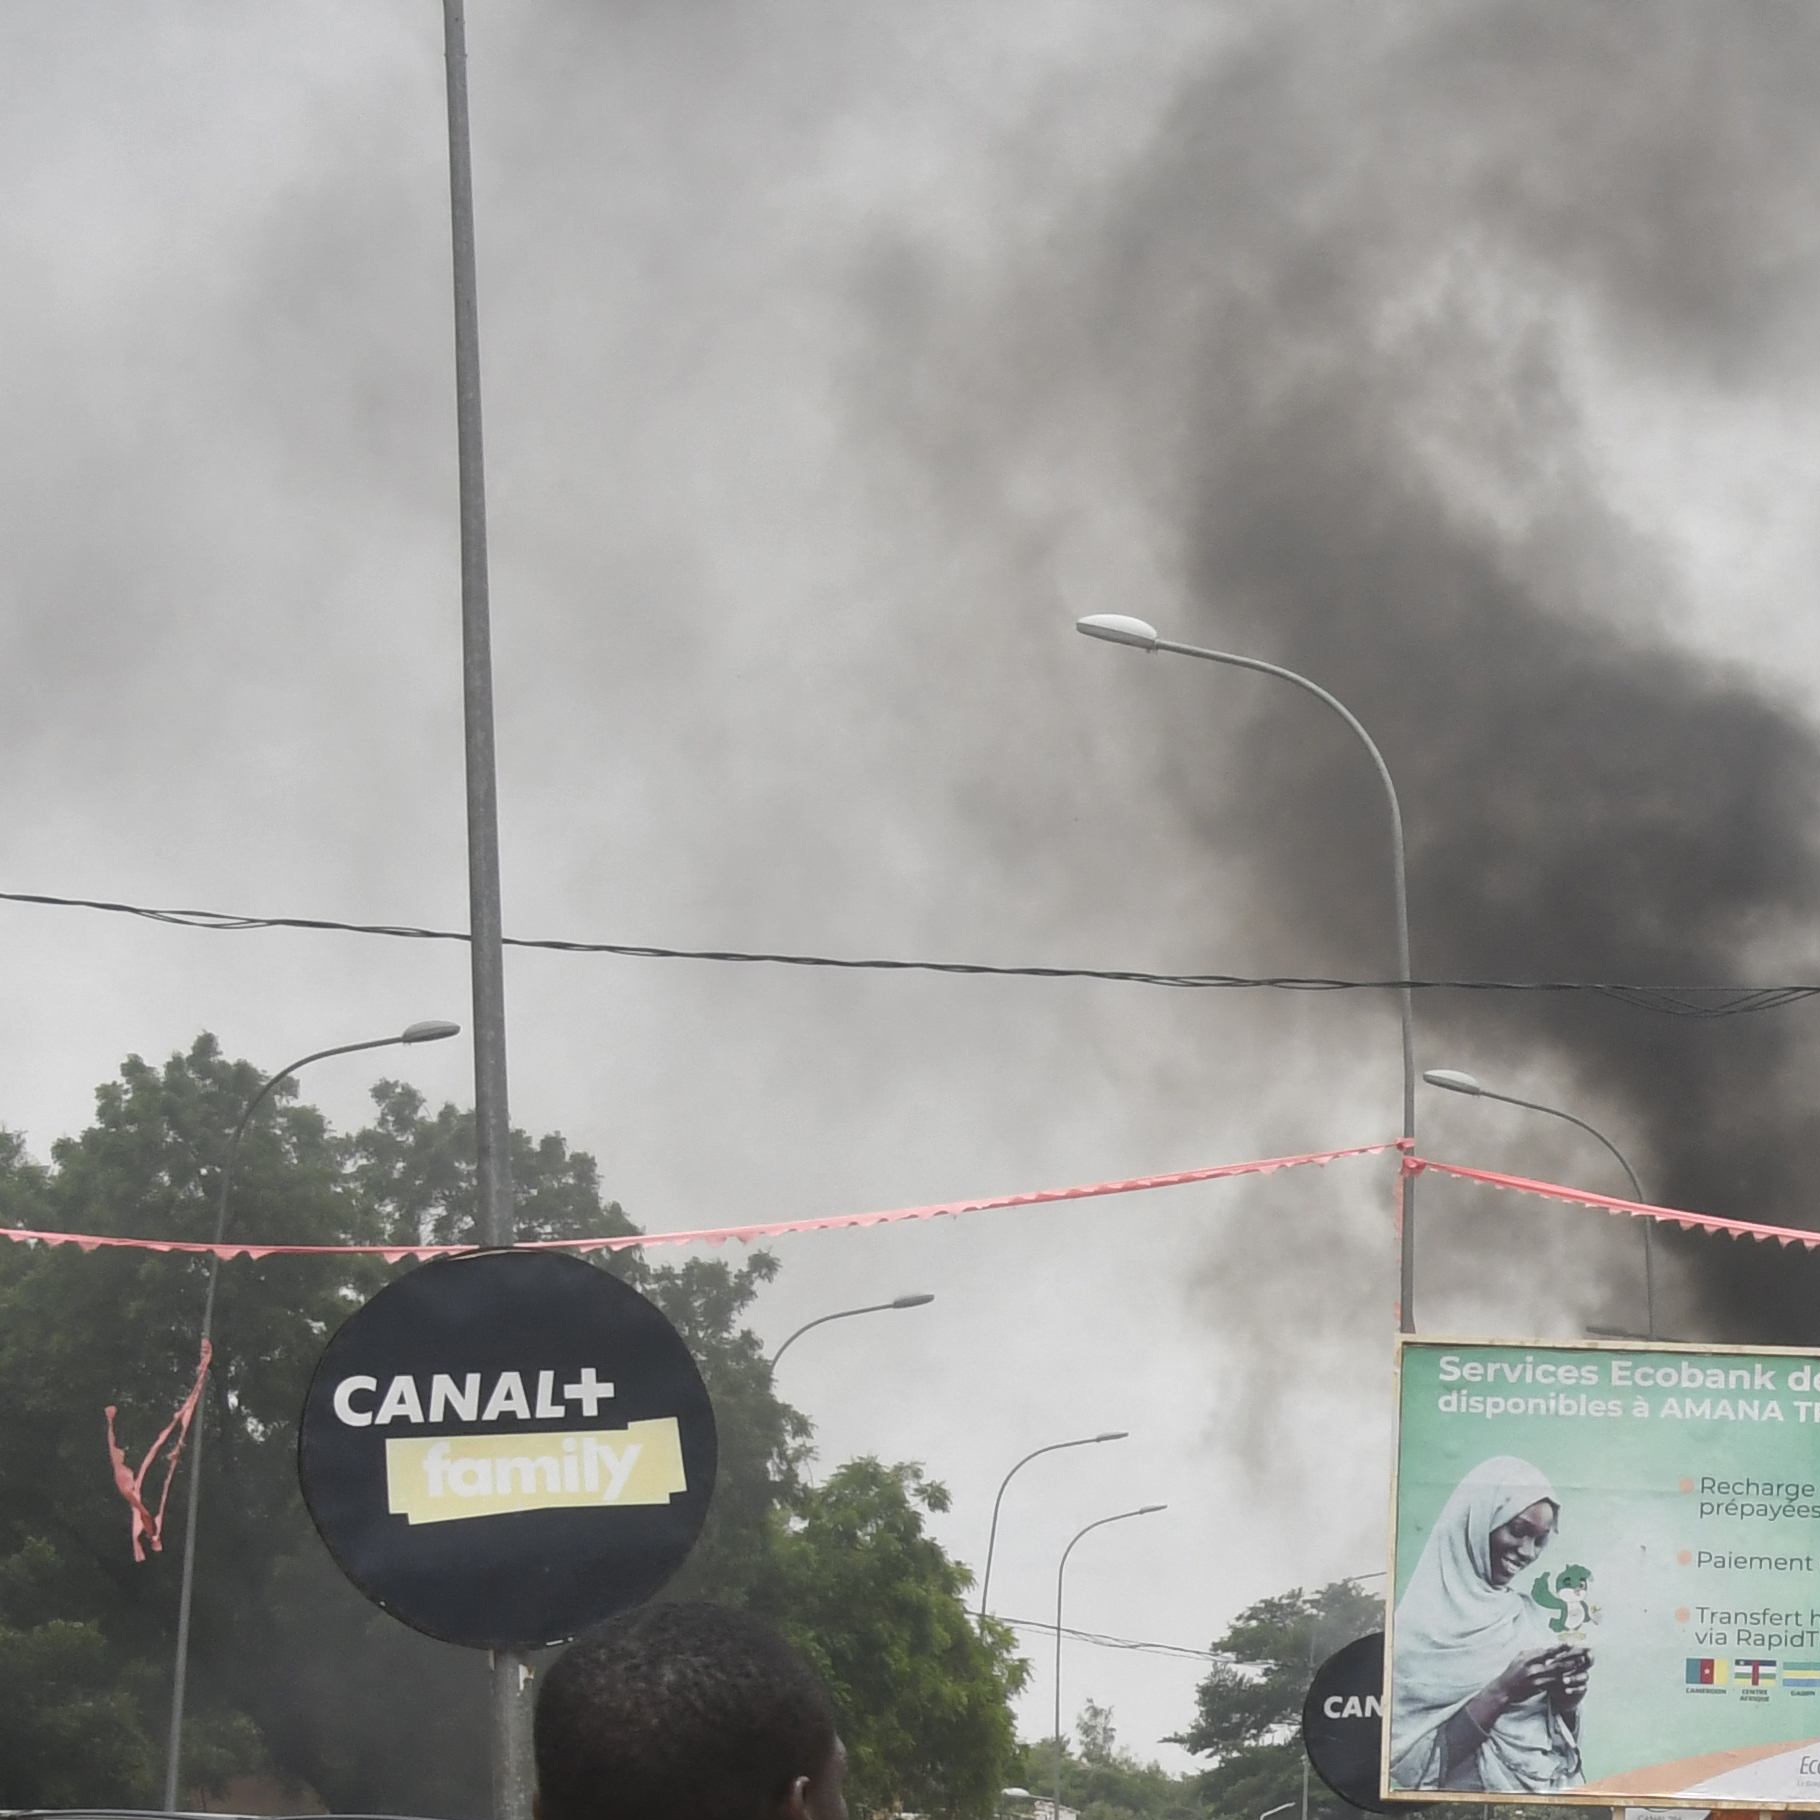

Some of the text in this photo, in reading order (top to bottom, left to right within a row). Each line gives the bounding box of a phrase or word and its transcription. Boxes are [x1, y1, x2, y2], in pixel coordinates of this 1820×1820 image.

[1439, 1355, 1599, 1385] Services
[1611, 1359, 1776, 1391] Ecobank
[333, 1367, 615, 1427] CANAL+
[1438, 1389, 1623, 1419] disponibles
[1632, 1394, 1649, 1418] à
[1660, 1397, 1785, 1422] AMANA
[422, 1436, 643, 1501] family
[1701, 1476, 1815, 1500] Recharge
[1697, 1551, 1814, 1572] Paiement
[1695, 1605, 1802, 1627] Transfert
[1695, 1628, 1727, 1646] via
